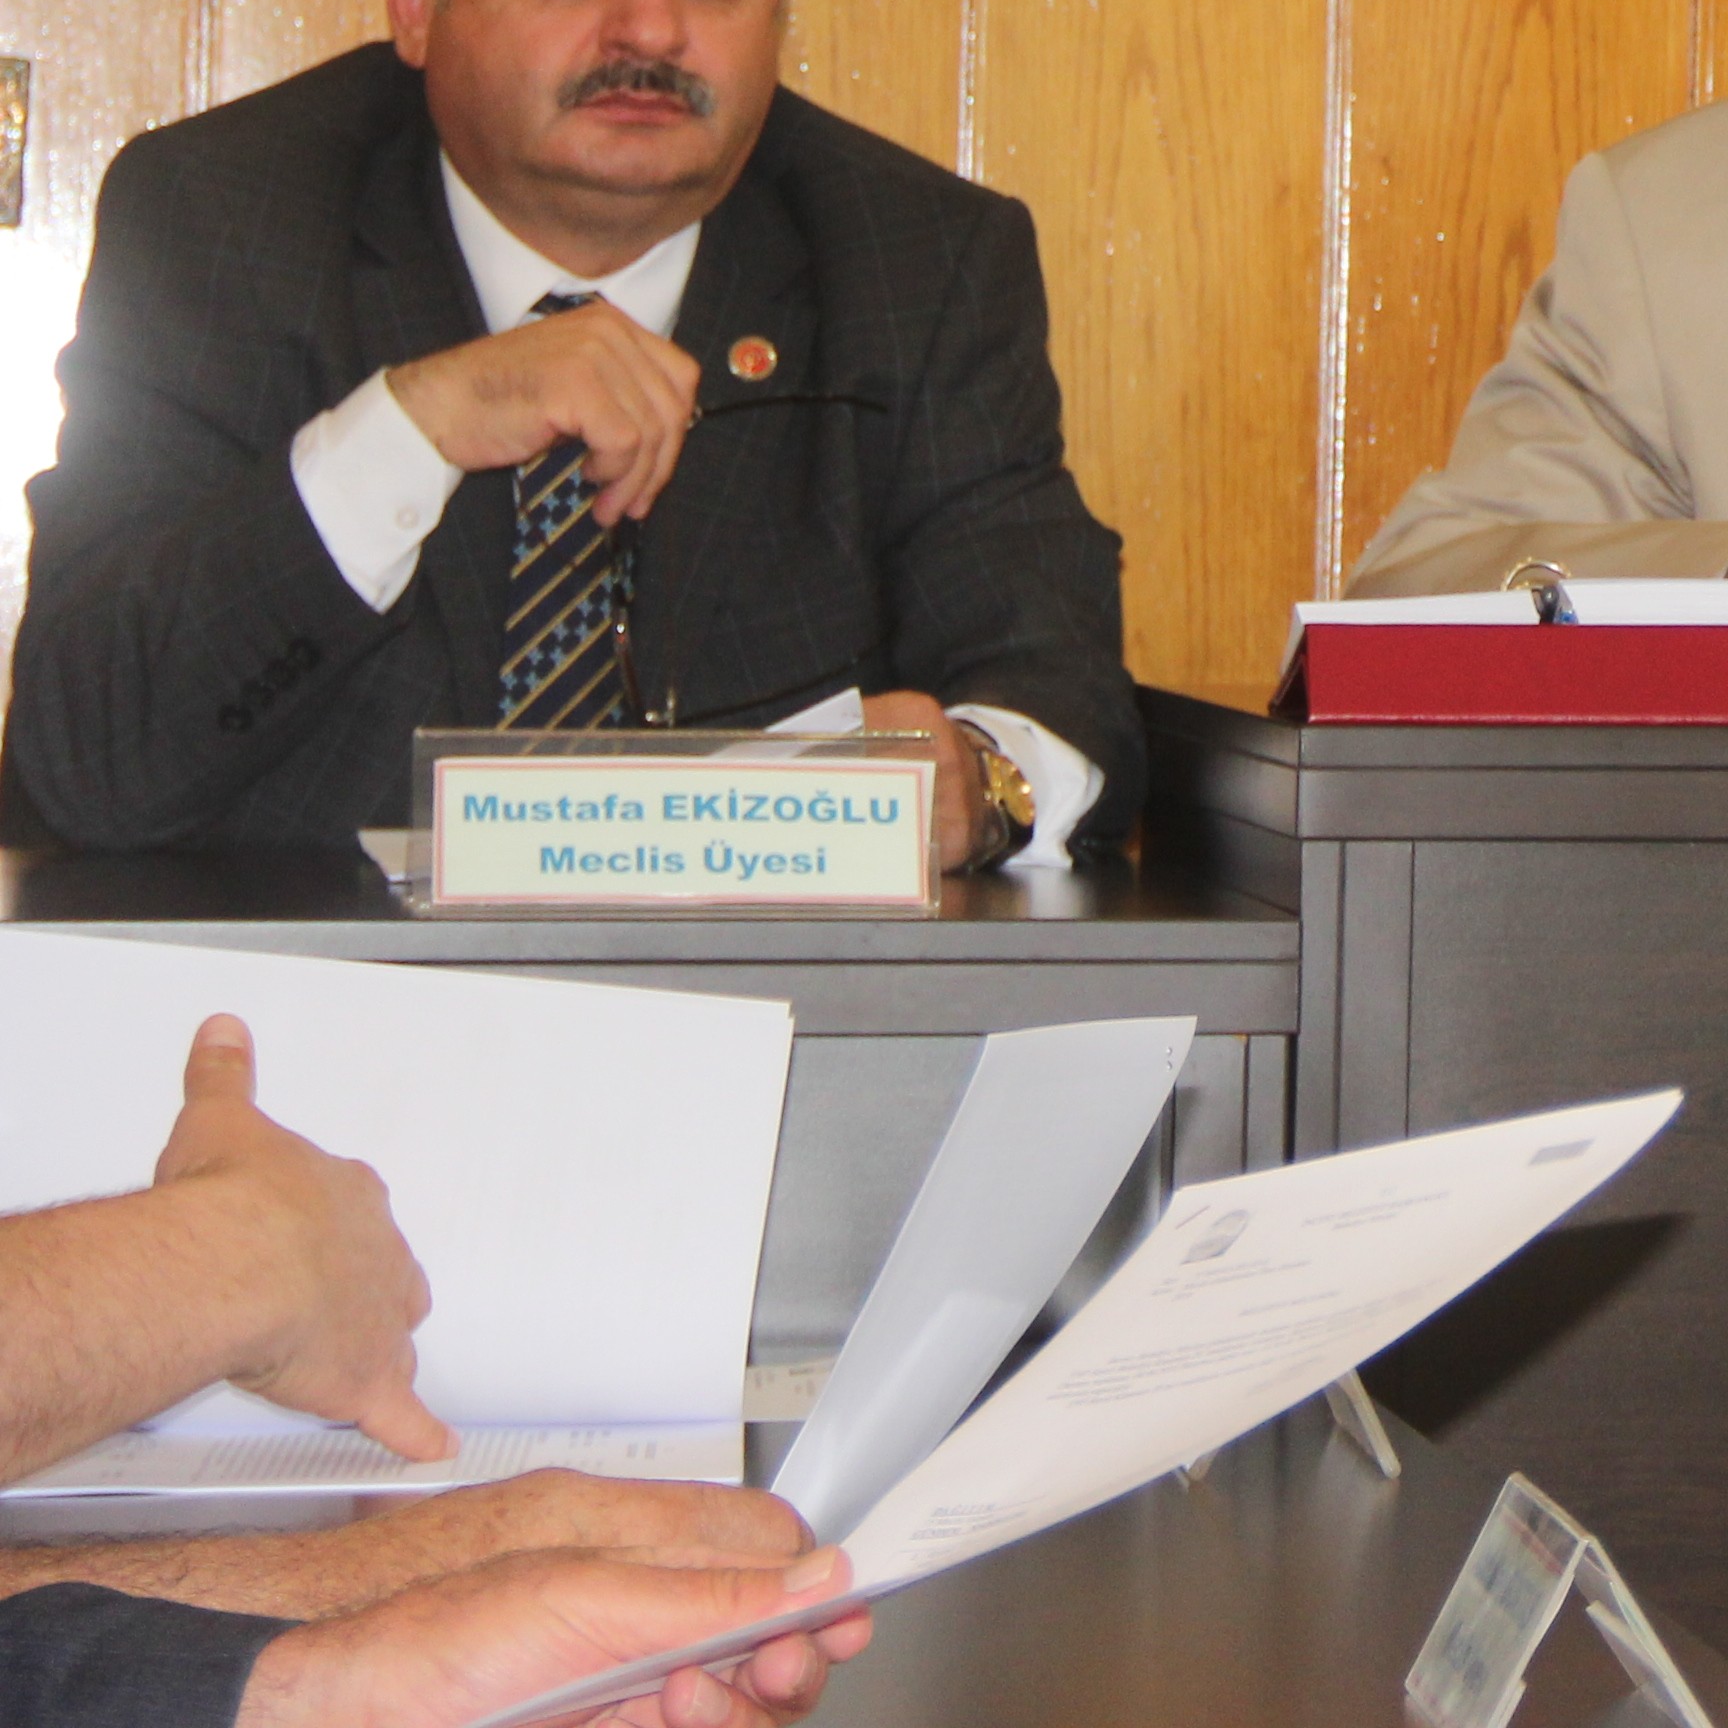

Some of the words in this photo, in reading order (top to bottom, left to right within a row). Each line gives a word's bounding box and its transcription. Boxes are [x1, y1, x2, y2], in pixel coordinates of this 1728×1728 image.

[463, 794, 644, 821] Mustafa
[662, 789, 899, 824] EKİZOĞLU
[540, 846, 685, 873] Meclis
[703, 840, 827, 880] Üyesi
